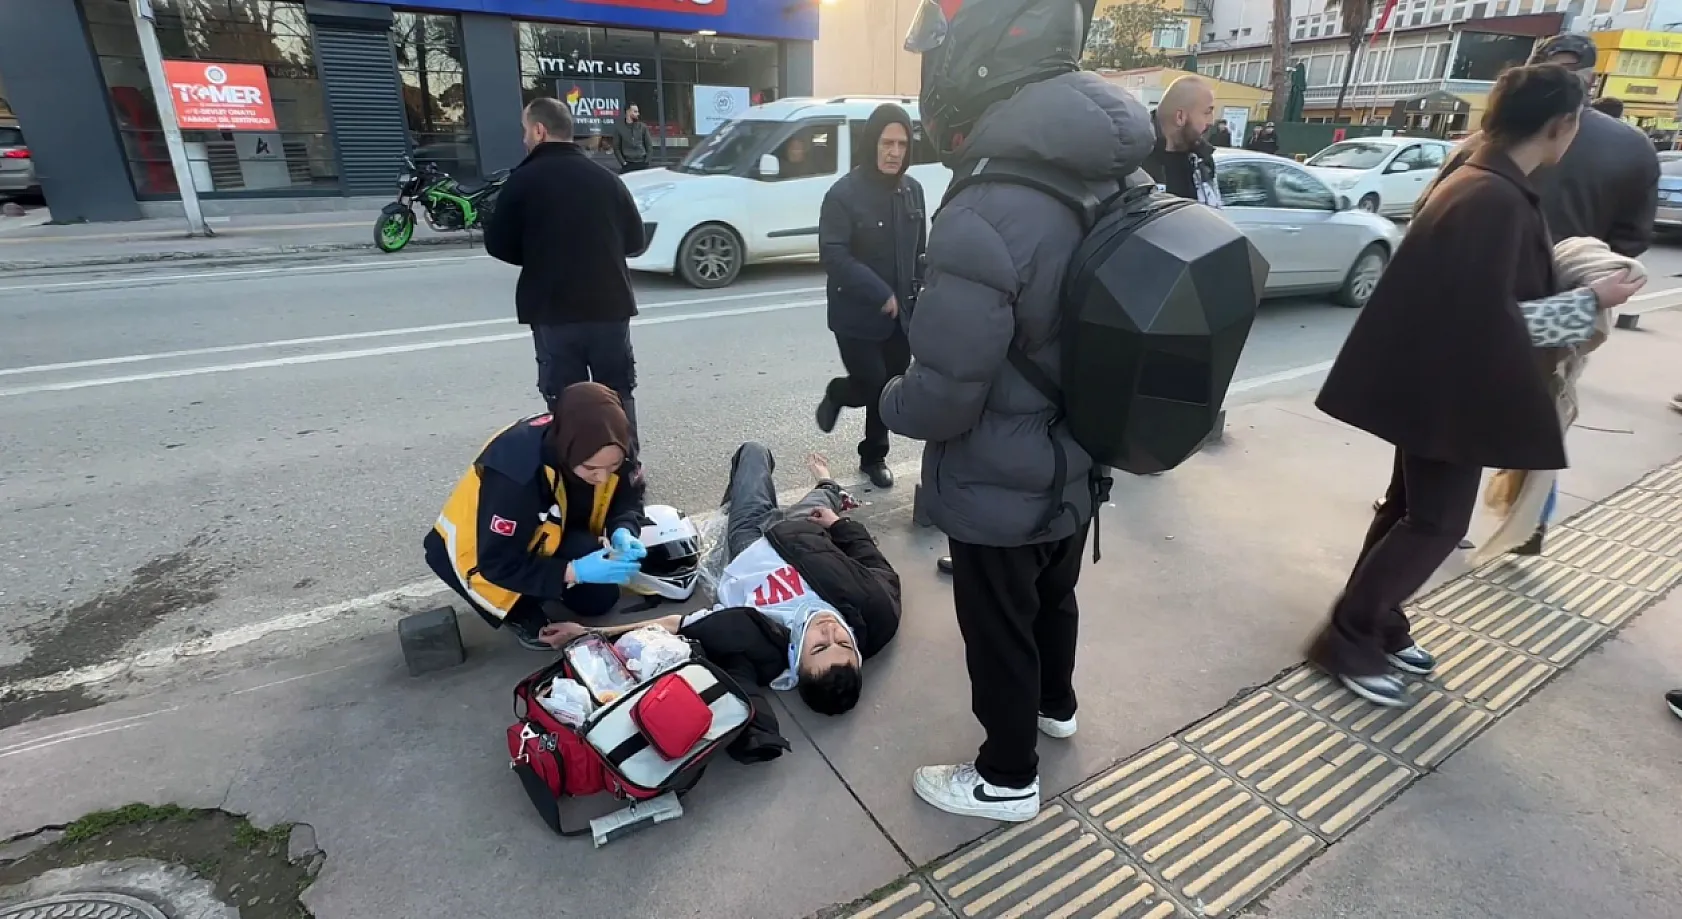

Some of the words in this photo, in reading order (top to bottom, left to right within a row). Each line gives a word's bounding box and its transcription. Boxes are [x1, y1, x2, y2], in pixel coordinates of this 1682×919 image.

[538, 57, 565, 72] TYT
[577, 59, 604, 74] AYT
[615, 61, 641, 75] LGS
